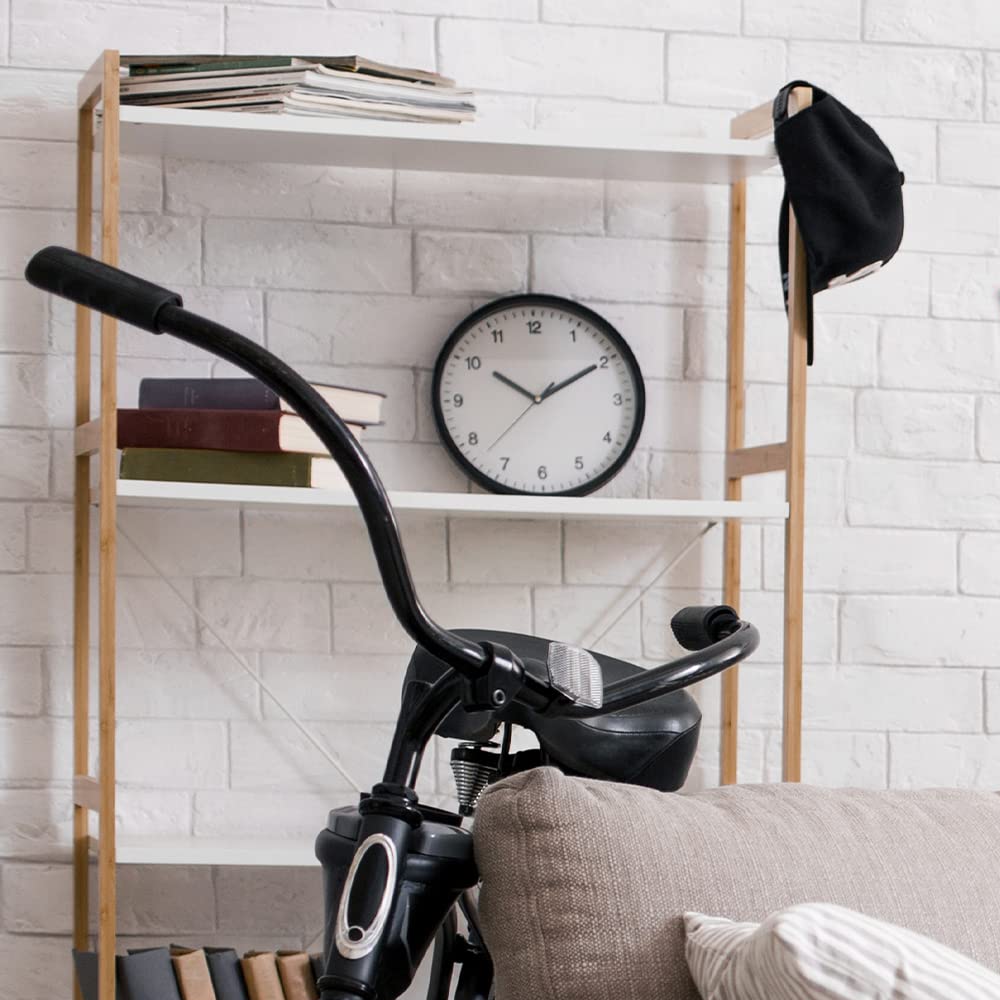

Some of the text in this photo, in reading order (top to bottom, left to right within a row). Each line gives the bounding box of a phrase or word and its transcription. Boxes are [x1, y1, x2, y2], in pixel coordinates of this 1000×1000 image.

[525, 321, 542, 334] 12
[491, 330, 503, 343] 11
[570, 330, 576, 343] 1
[465, 356, 481, 370] 10
[599, 356, 609, 369] 2
[453, 394, 464, 408] 9
[613, 393, 622, 406] 3
[468, 432, 478, 446] 8
[602, 431, 612, 444] 4
[500, 457, 510, 471] 7
[574, 456, 584, 470] 5
[537, 466, 547, 480] 6
